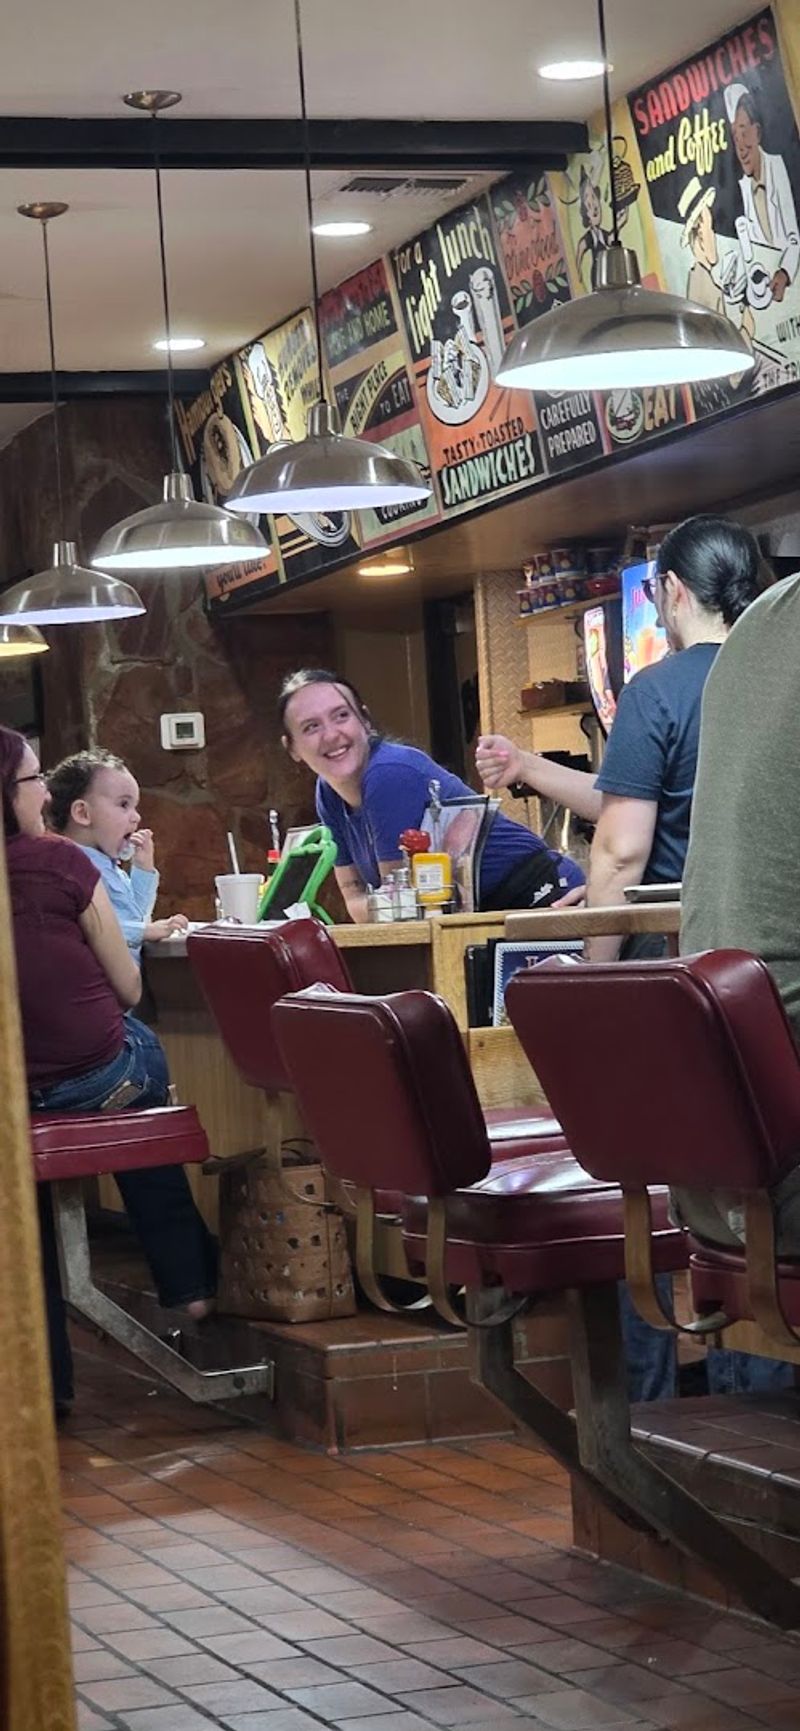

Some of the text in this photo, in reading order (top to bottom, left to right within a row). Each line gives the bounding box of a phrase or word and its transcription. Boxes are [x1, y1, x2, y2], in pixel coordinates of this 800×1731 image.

[634, 19, 774, 136] SANDWICHES
[646, 108, 728, 182] and Coffee
[414, 241, 423, 264] a
[406, 206, 496, 354] light lunch
[362, 301, 391, 336] HOME
[350, 360, 388, 431] RIGHT PLACE
[380, 377, 411, 415] TO EAT
[540, 392, 592, 430] CAREFULLY
[642, 385, 677, 431] EAT
[443, 416, 525, 465] TASTY TOASTED
[547, 420, 597, 459] PREPARED
[441, 432, 536, 505] SANDWICHES
